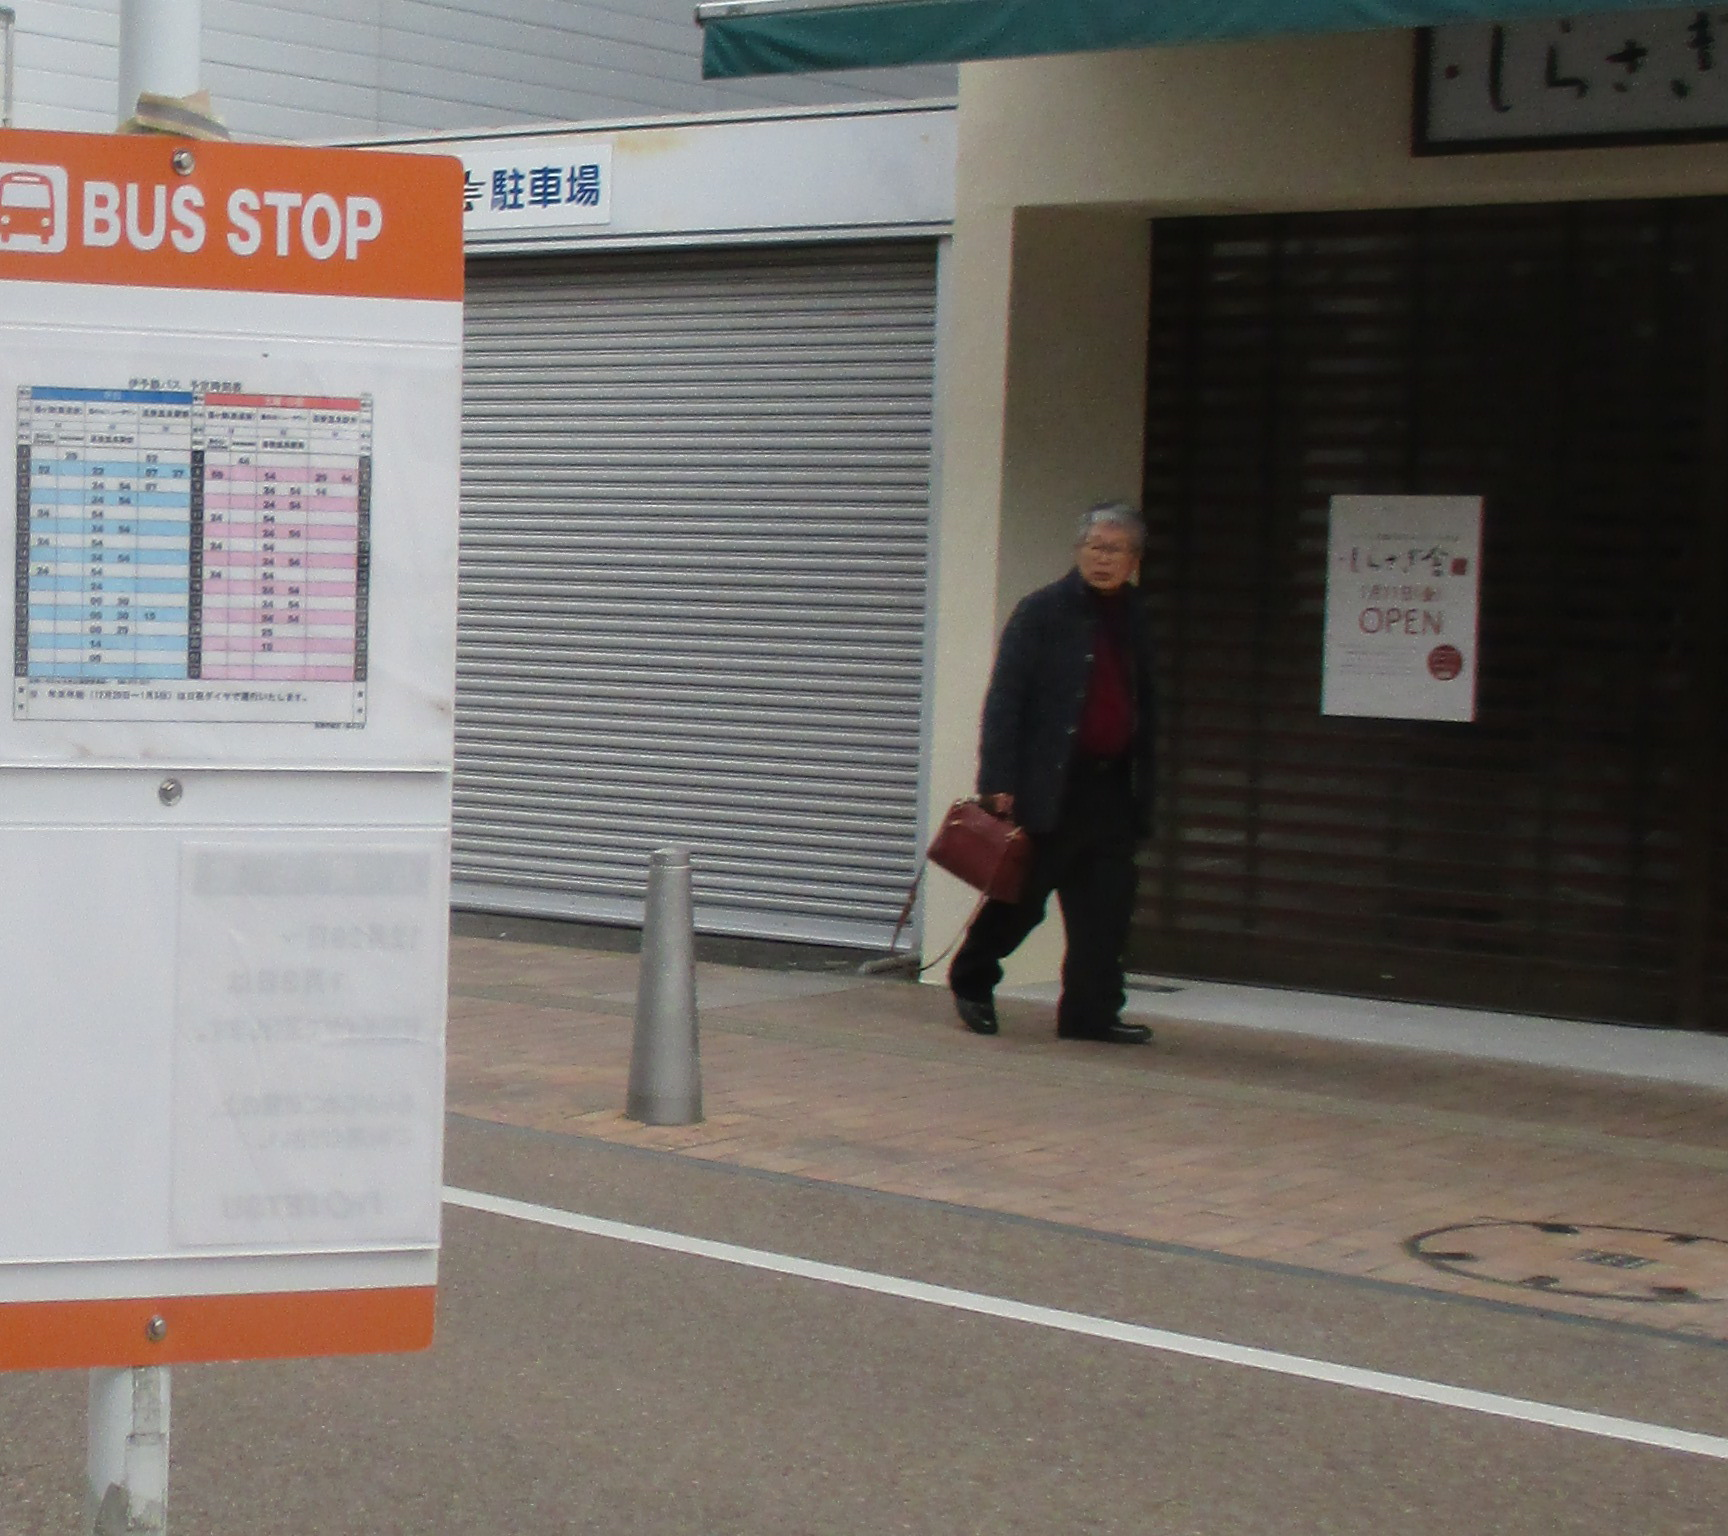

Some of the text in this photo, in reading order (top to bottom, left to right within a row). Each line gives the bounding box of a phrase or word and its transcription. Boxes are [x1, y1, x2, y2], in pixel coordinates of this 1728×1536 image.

[82, 180, 383, 261] BUS STOP
[1359, 607, 1442, 635] OPEN
